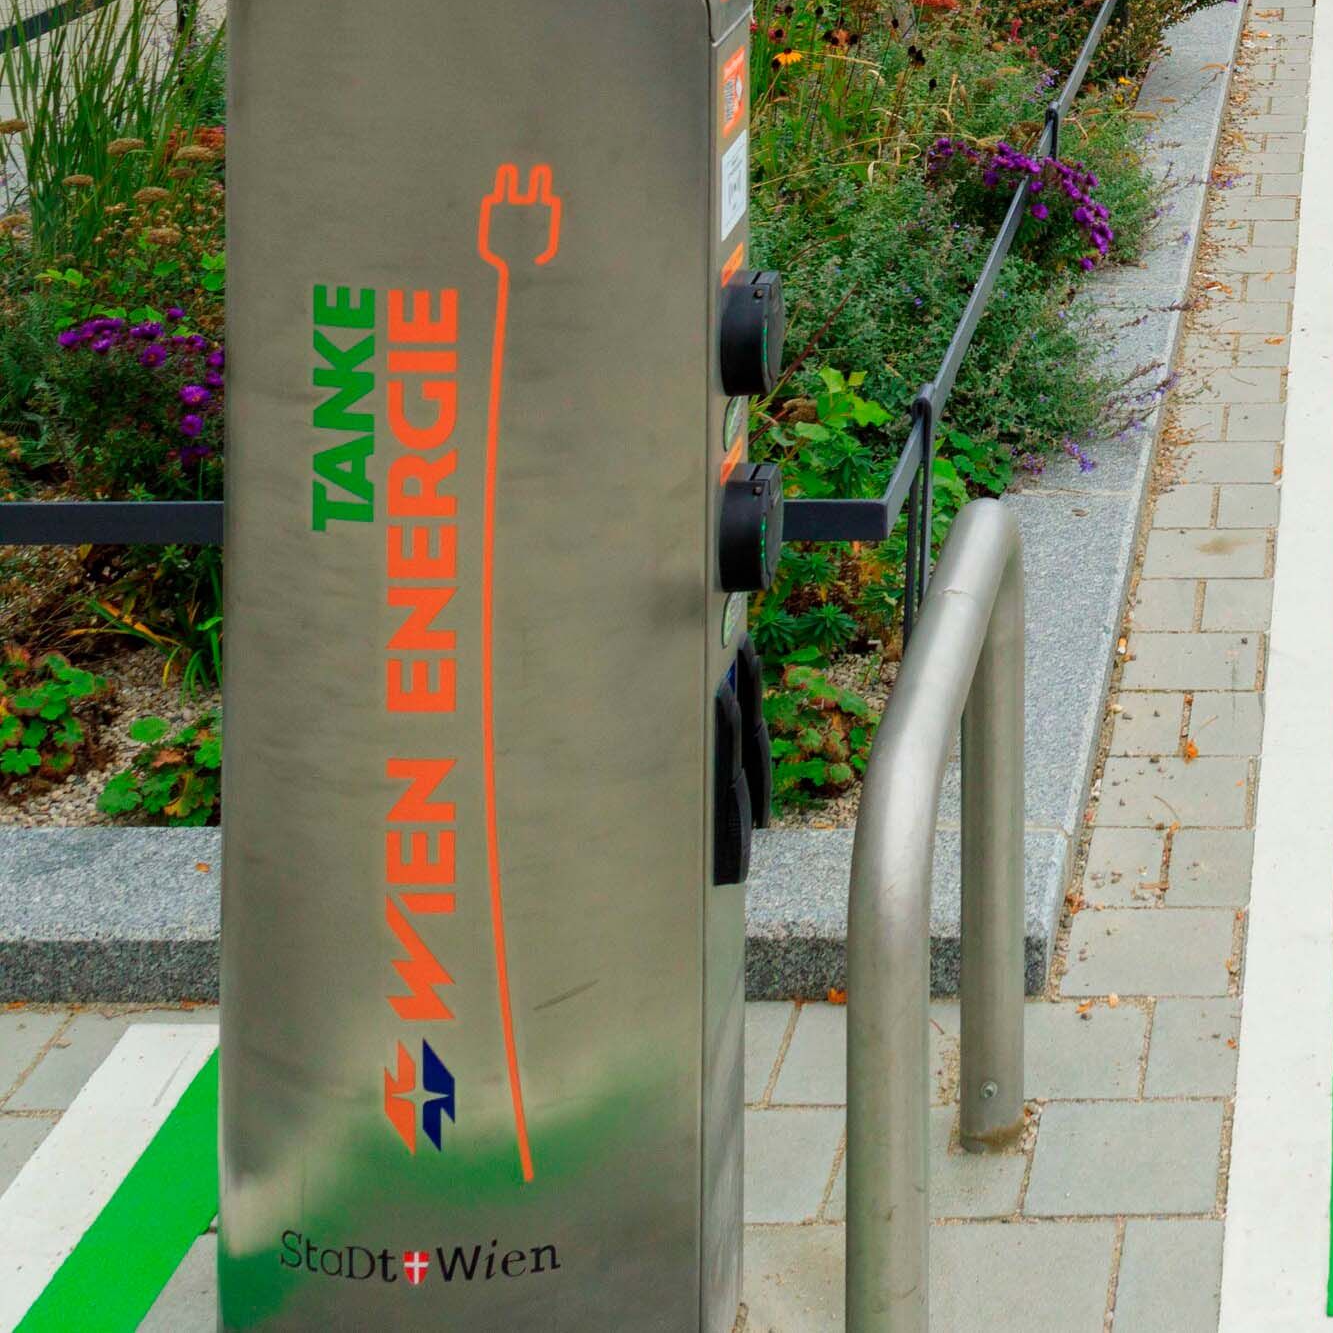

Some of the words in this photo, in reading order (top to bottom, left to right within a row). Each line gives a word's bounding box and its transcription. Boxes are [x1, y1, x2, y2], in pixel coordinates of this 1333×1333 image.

[312, 283, 376, 532] TANKE
[385, 287, 459, 713] ENERGIE
[384, 757, 458, 1021] WIEN
[435, 1238, 561, 1283] Wien
